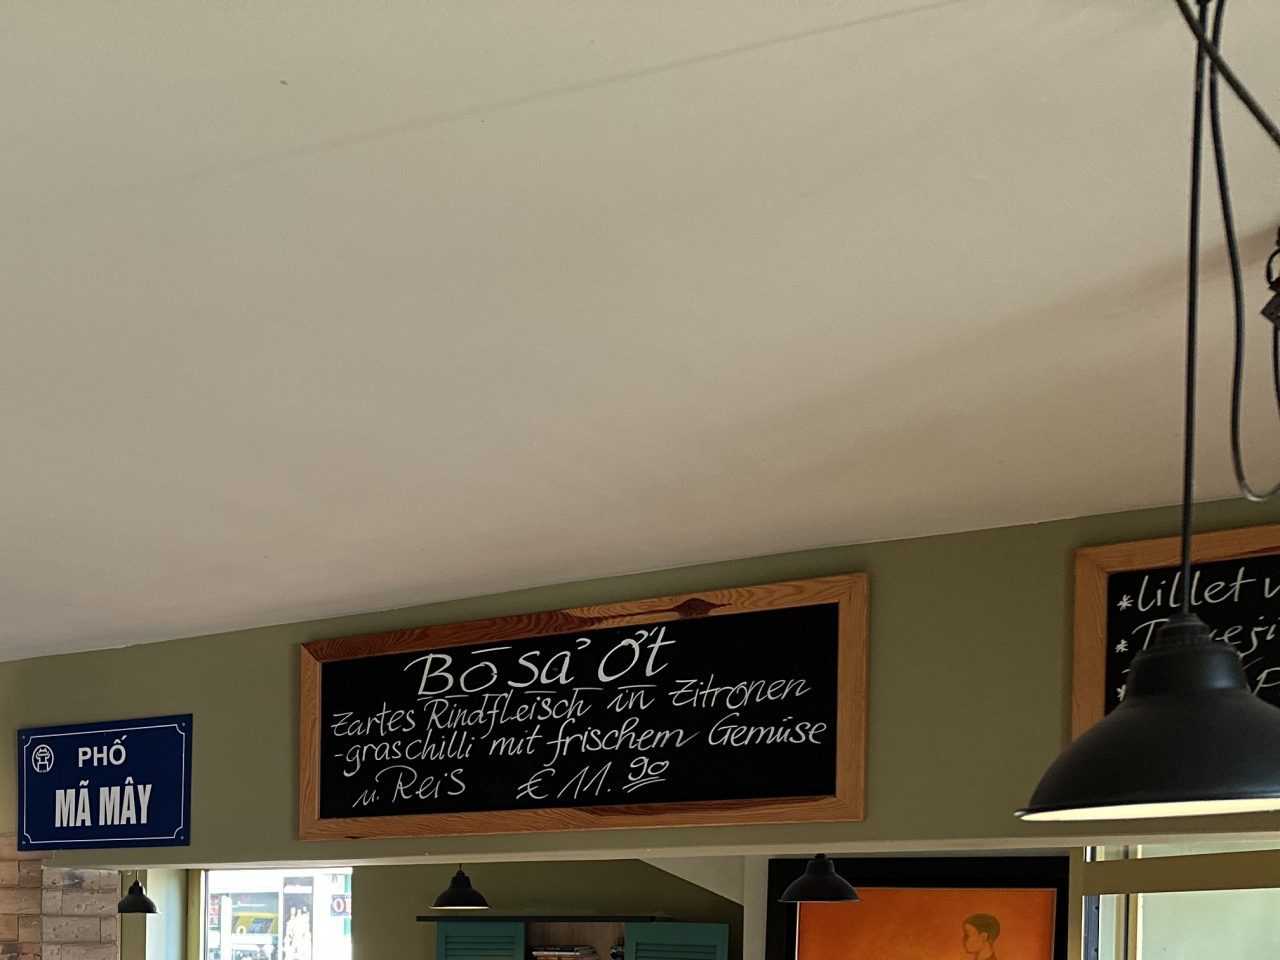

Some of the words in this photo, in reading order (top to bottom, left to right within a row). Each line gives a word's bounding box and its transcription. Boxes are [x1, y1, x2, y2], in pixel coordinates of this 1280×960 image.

[423, 688, 592, 740] Rindfleisch
[607, 689, 655, 712] in
[668, 673, 812, 710] Zitronen
[77, 734, 127, 768] PHỐ
[489, 724, 543, 756] mit
[543, 716, 701, 767] frischem
[708, 712, 827, 747] Gemüse
[54, 779, 92, 828] MÃ
[98, 776, 153, 827] MÂY
